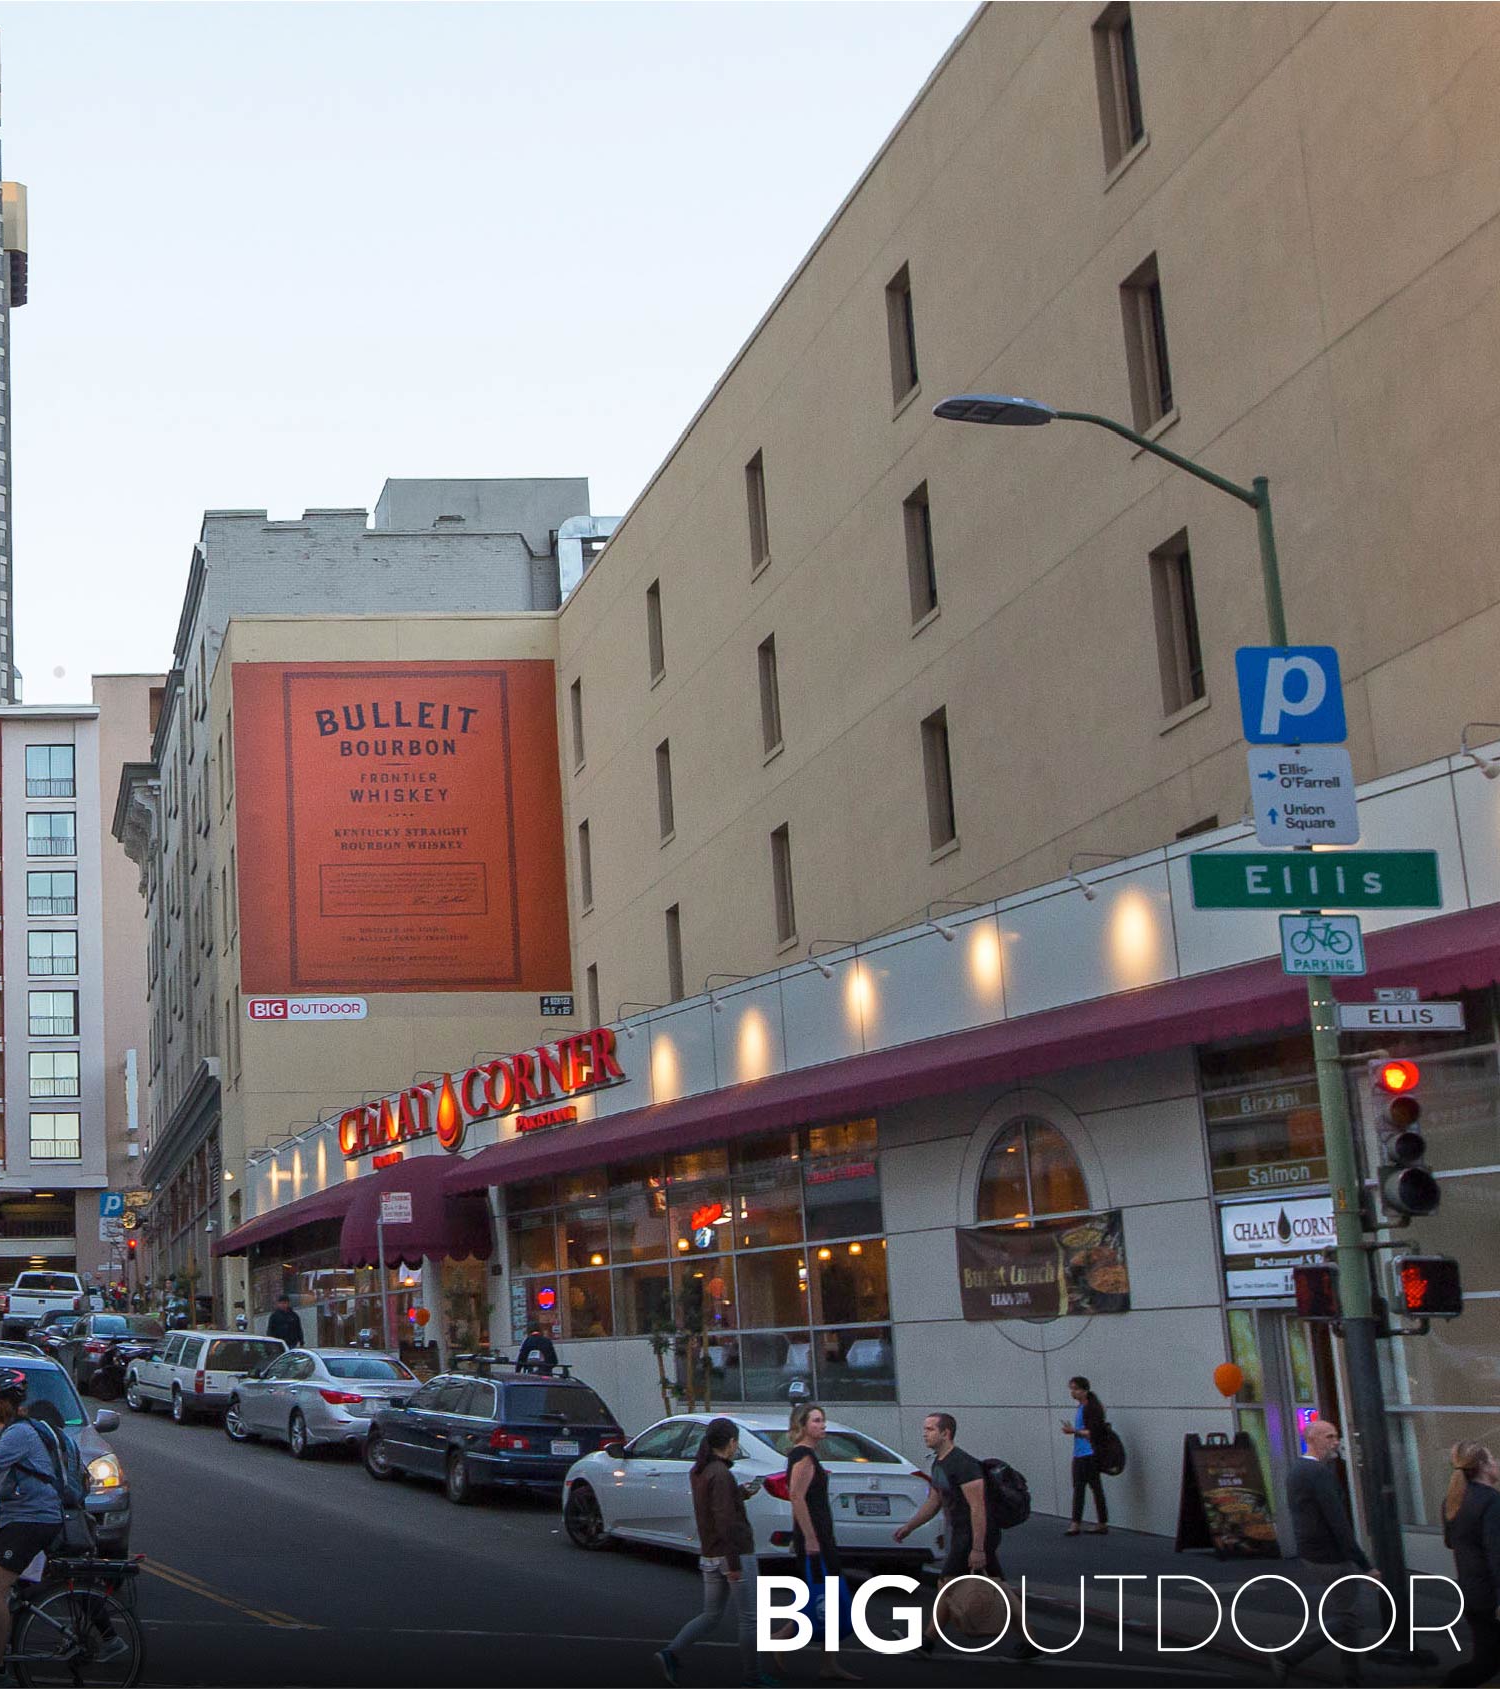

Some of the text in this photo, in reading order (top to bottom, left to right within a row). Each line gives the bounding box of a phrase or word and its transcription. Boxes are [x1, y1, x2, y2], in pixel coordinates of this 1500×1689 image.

[315, 700, 479, 737] BULLEIT
[340, 740, 457, 757] BOURBON
[1278, 763, 1313, 775] Ellis-
[360, 772, 438, 784] FRONTIER
[1280, 776, 1341, 789] O'Farrell
[350, 788, 449, 803] WHISKEY
[1283, 803, 1325, 816] Union
[1285, 817, 1336, 831] Square
[334, 827, 469, 838] KENTUCKY STRAIGHT
[341, 840, 463, 851] BOURBON WHISKEY
[1245, 865, 1383, 895] Ellis
[1294, 959, 1355, 972] PARKING
[254, 1003, 361, 1017] BIG OUTDOOR
[1368, 1009, 1433, 1024] ELLIS
[339, 1027, 625, 1155] CHAAT CORNER
[1248, 1165, 1310, 1186] Salmon
[1233, 1221, 1276, 1242] CHAAT
